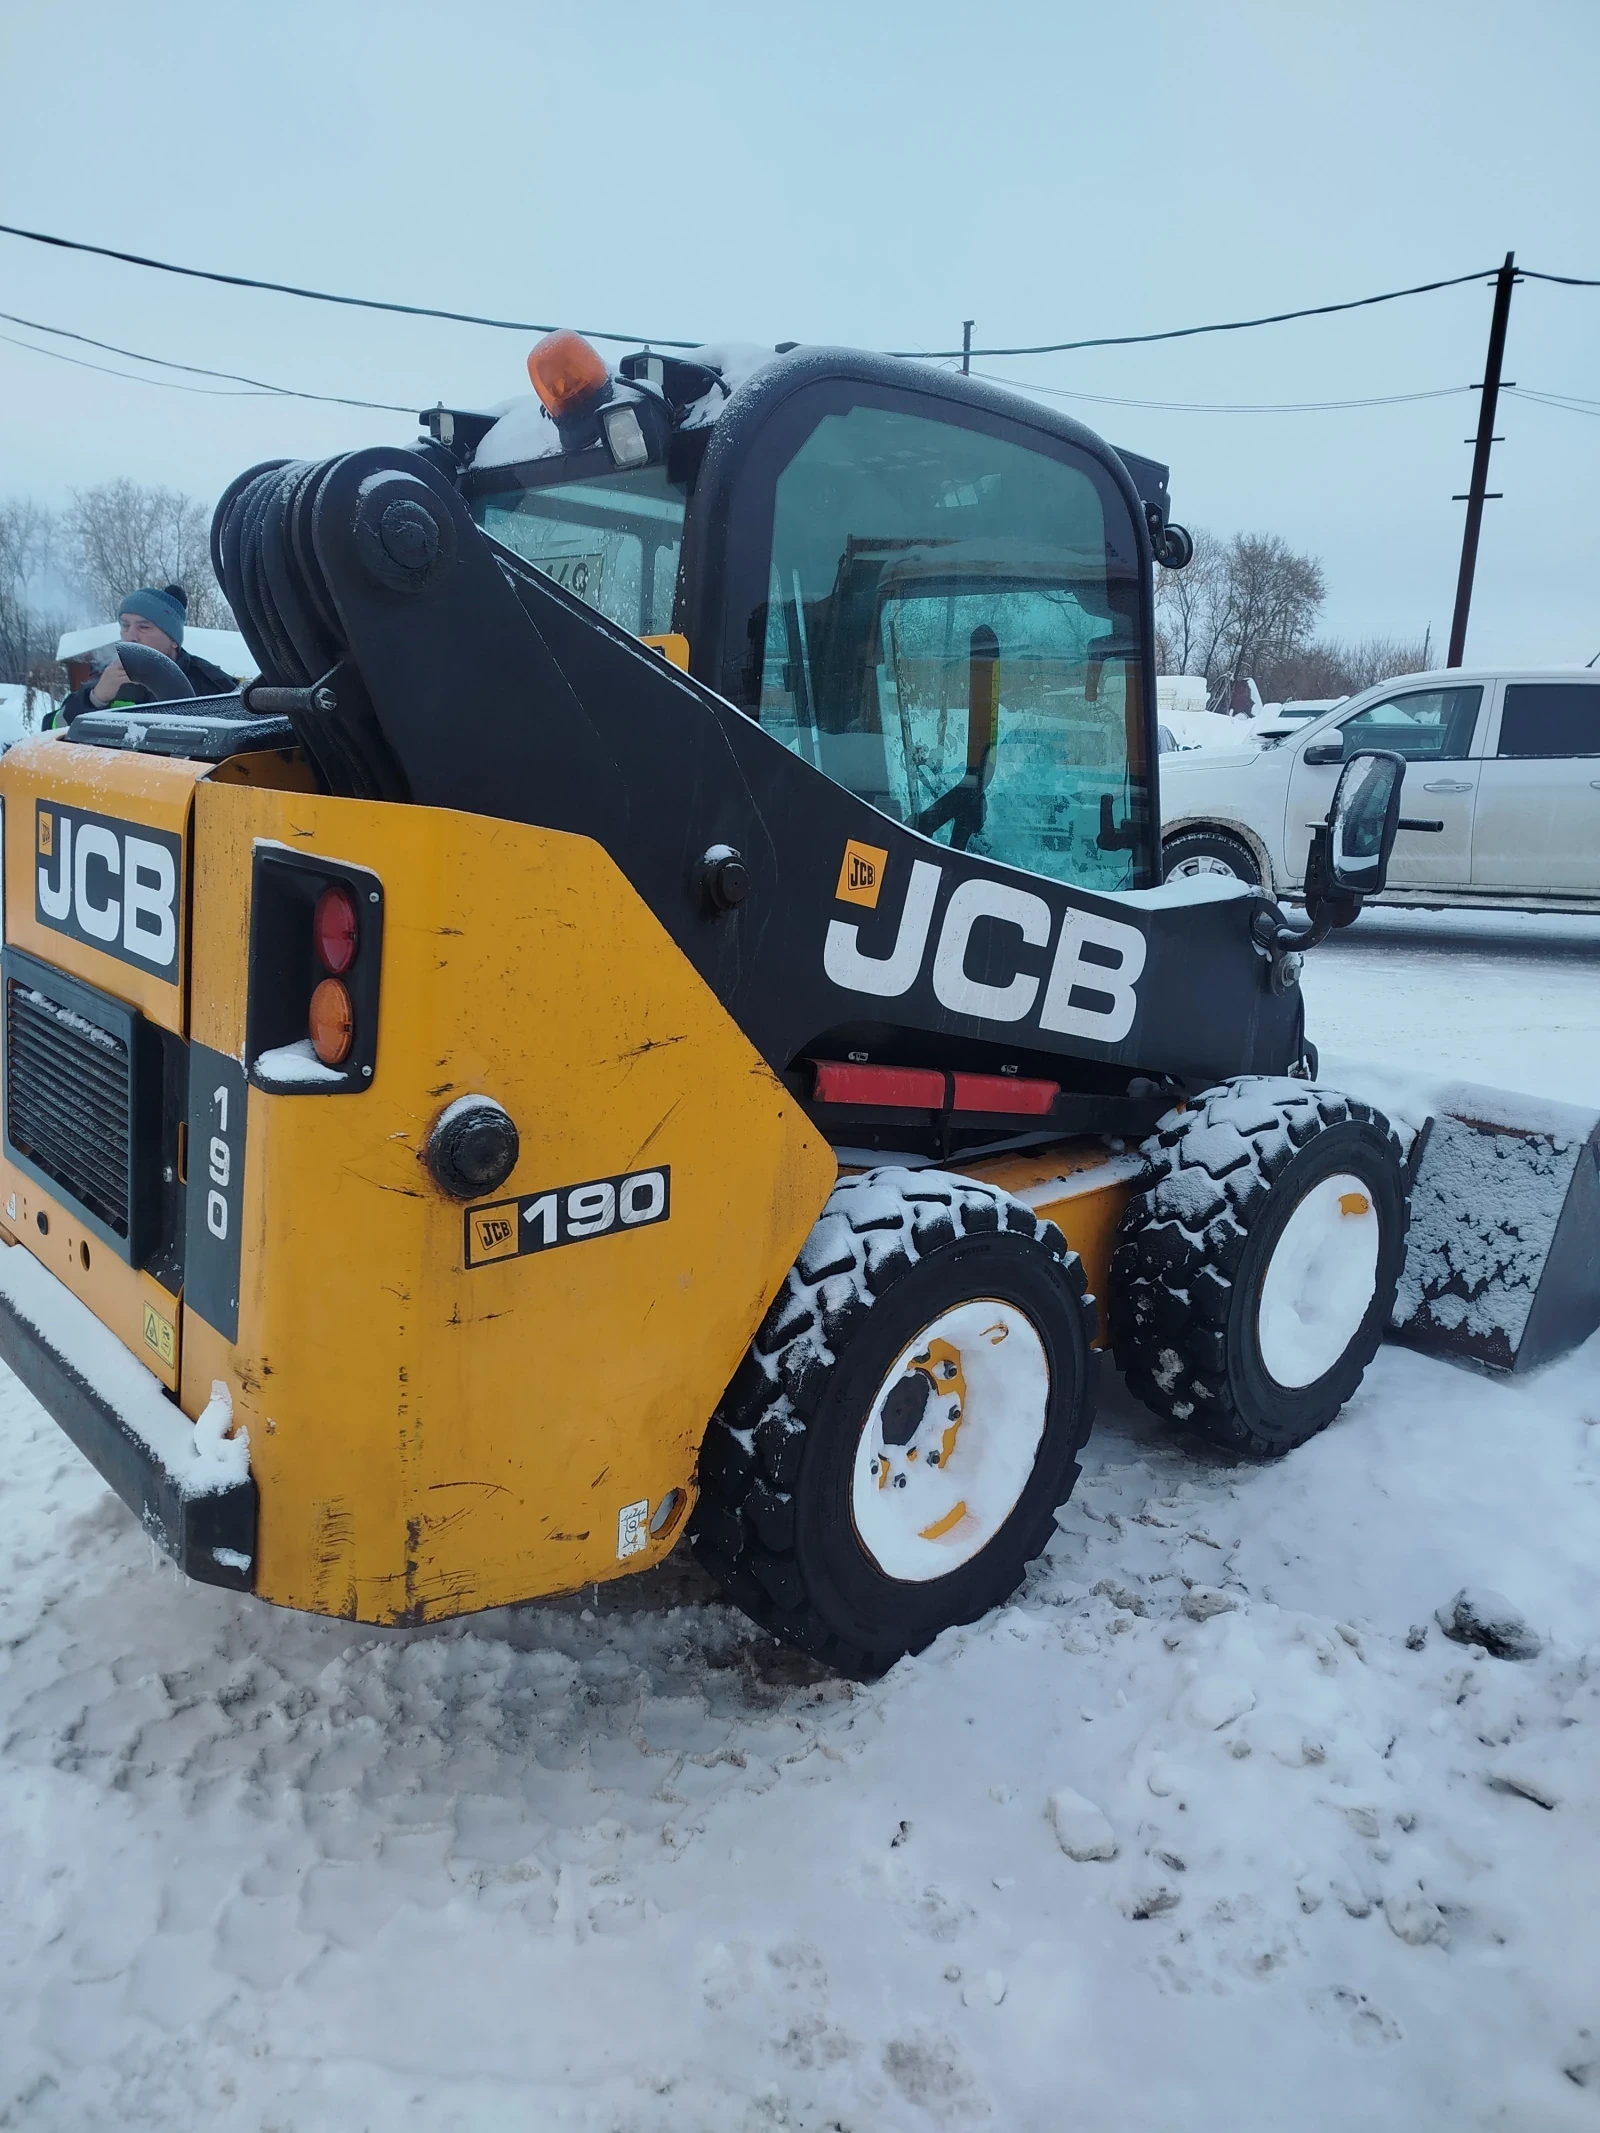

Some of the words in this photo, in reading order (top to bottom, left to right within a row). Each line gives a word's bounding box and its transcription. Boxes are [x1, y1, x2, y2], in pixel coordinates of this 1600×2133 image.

[38, 816, 175, 966] JCB
[851, 858, 873, 886] JCB
[823, 859, 1147, 1043] JCB
[207, 1085, 230, 1240] 190
[483, 1222, 510, 1247] JCB
[522, 1171, 665, 1244] 190
